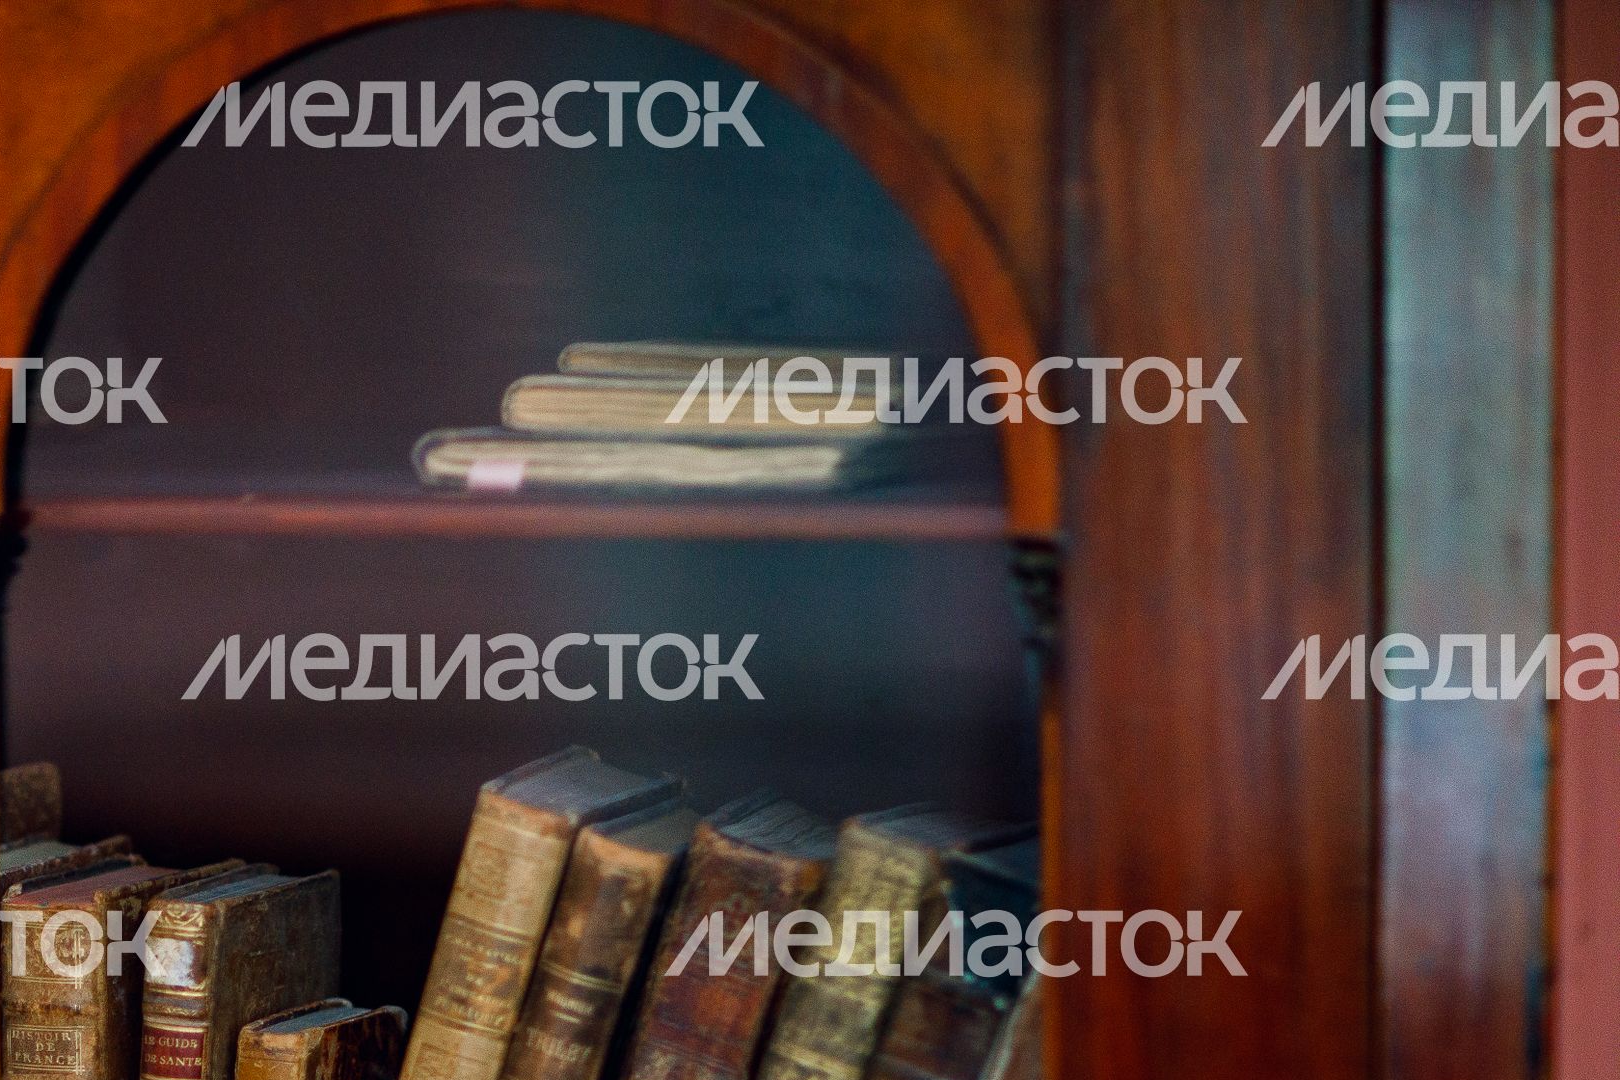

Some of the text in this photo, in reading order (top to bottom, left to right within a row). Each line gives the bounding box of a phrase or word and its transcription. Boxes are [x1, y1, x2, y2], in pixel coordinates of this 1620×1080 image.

[12, 1029, 80, 1042] HISTOIR
[35, 1042, 56, 1053] DE
[158, 1036, 199, 1049] GUIDE
[14, 1052, 77, 1065] FRANCE
